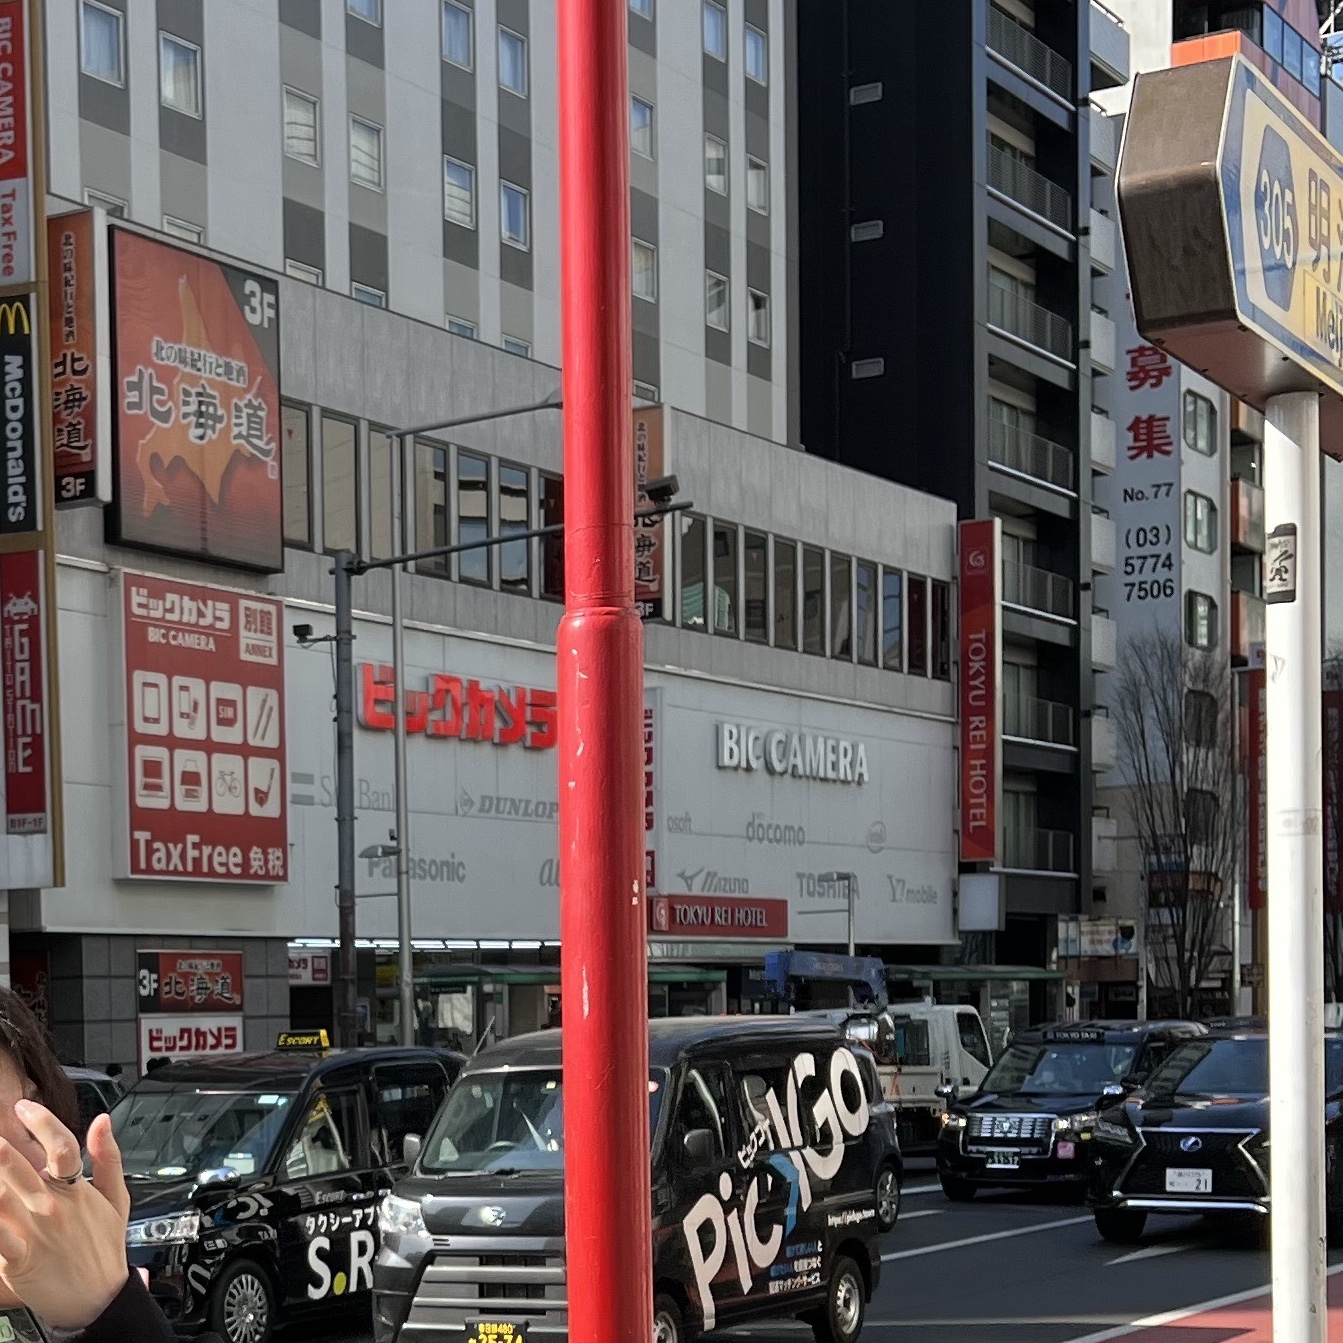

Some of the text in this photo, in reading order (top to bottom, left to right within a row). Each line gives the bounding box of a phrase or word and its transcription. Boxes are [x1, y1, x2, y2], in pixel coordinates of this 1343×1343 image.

[0, 187, 18, 277] Tax Free
[1260, 168, 1295, 269] 305
[243, 279, 276, 329] 3F
[53, 351, 91, 455] 北海道
[124, 367, 276, 460] 北海道
[1, 353, 27, 525] McDonald's
[60, 476, 86, 499] 3F
[1124, 523, 1172, 550] (03)
[1123, 552, 1174, 576] 5774
[1123, 578, 1175, 602] 7506
[130, 586, 232, 631] ビックカメラ
[147, 626, 217, 653] BIC CAMERA
[968, 628, 988, 834] TOKYU REI HOTEL
[720, 722, 870, 783] BIC CAMERA
[745, 812, 806, 846] docomo
[249, 845, 285, 877] 免税
[673, 904, 770, 929] TOKYU REI HOTEL
[138, 968, 159, 997] 3F
[162, 973, 235, 1004] 北海道
[148, 1026, 238, 1053] ビックカメラ
